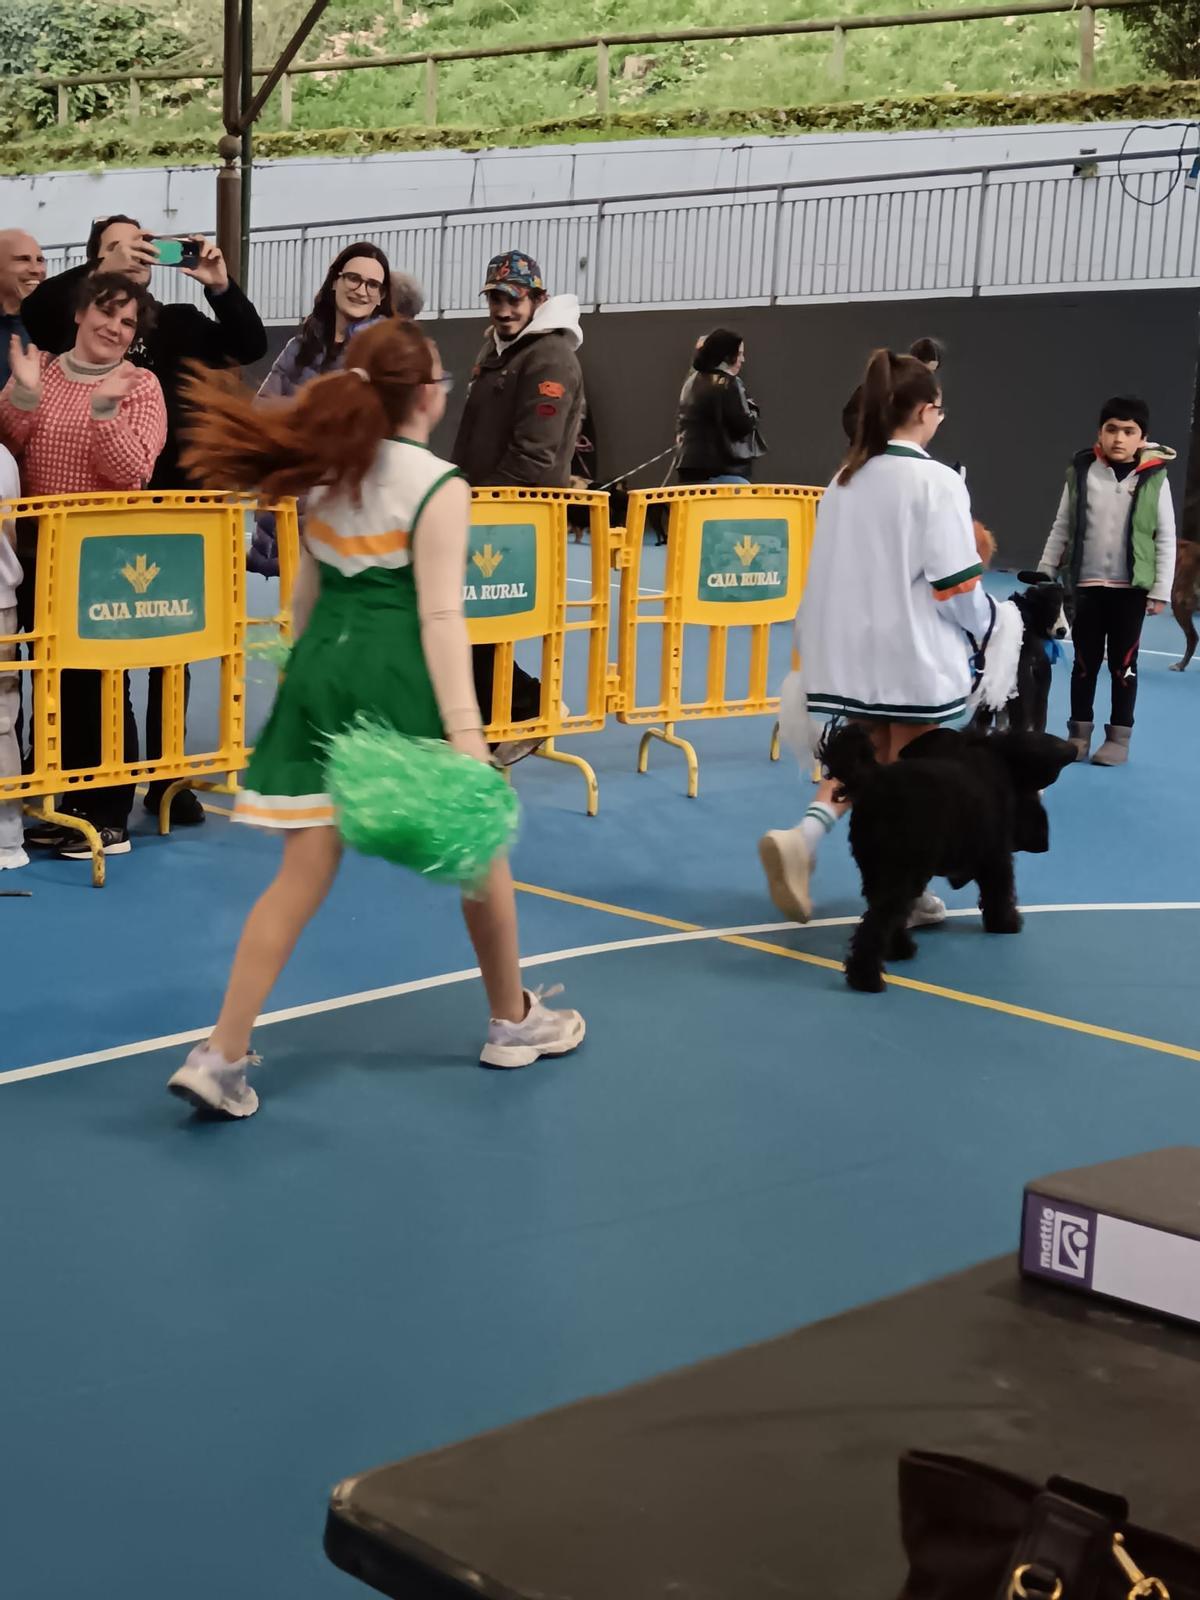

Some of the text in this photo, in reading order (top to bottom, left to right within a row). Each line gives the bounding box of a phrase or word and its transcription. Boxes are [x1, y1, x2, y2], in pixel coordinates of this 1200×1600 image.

[705, 571, 781, 587] CAJA RURAL
[463, 582, 528, 600] JA RURAL
[89, 599, 193, 620] CAJA RURAL
